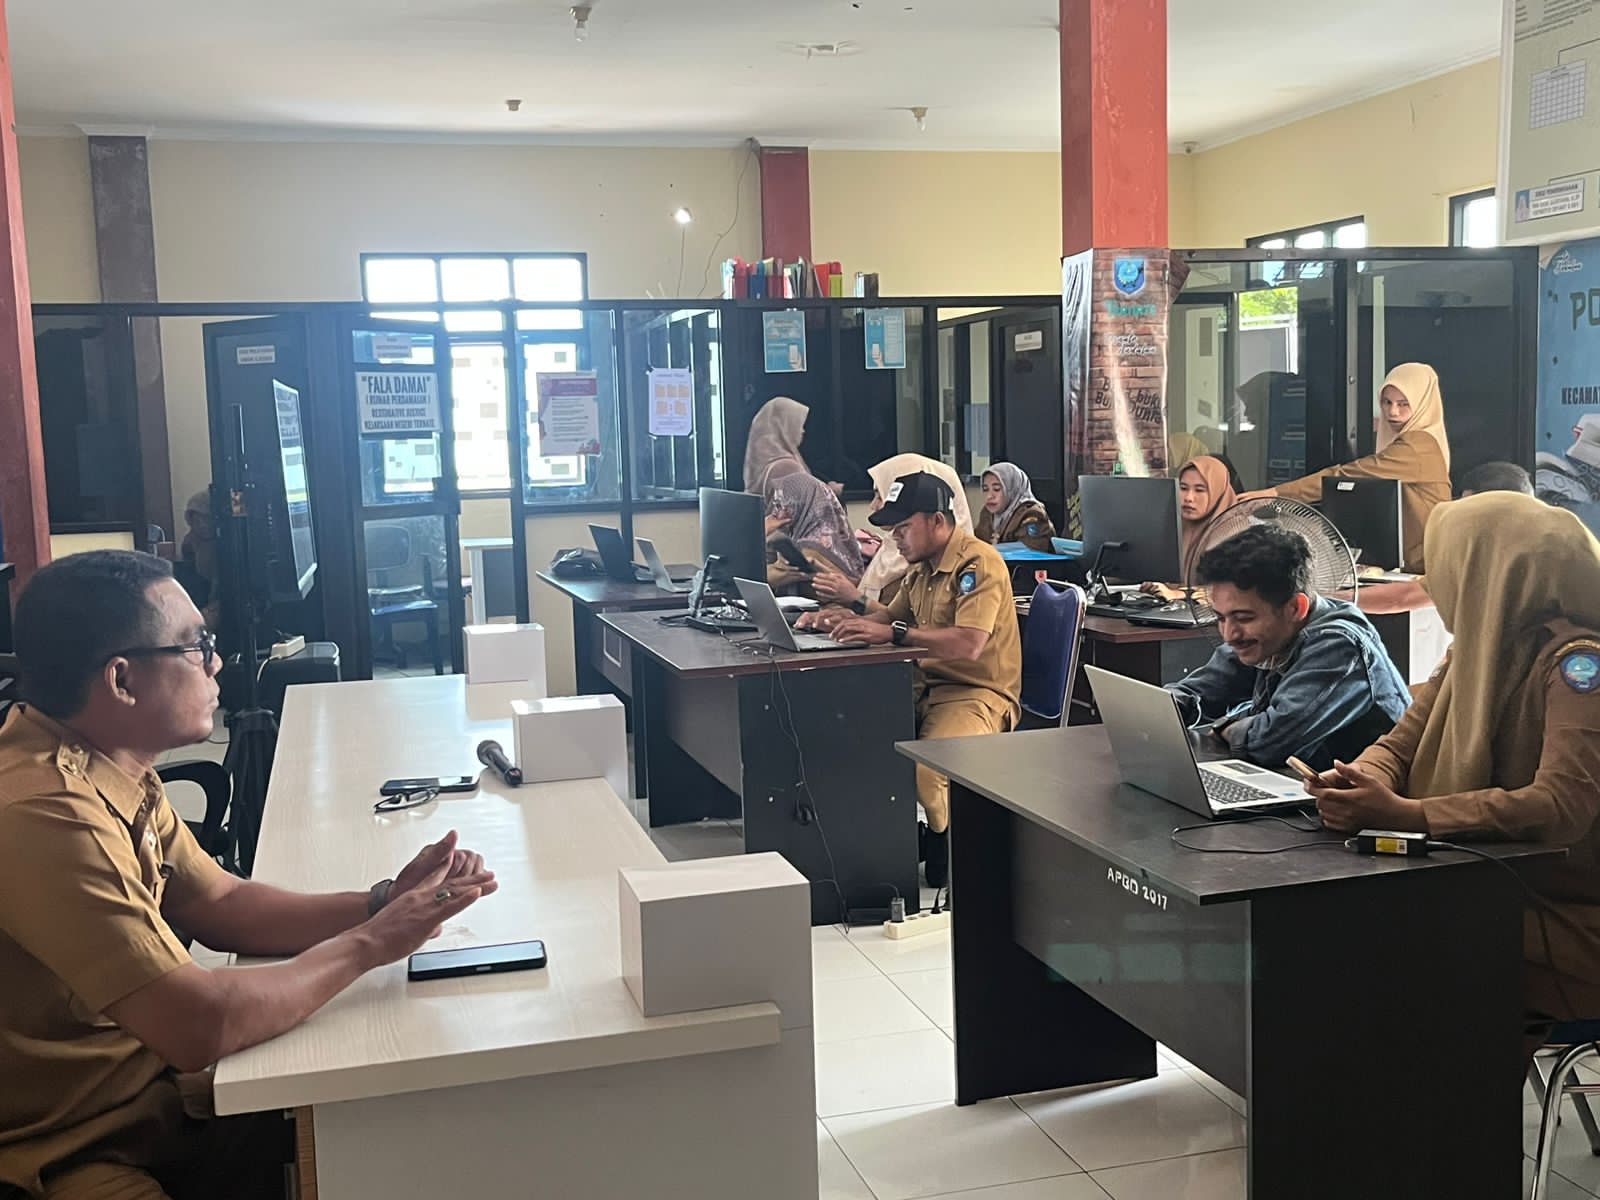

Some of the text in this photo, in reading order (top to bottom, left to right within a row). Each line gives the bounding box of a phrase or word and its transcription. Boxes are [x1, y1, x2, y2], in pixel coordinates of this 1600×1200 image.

[361, 375, 431, 393] "FALA DAMAI"
[1107, 867, 1167, 911] APBD 2017
